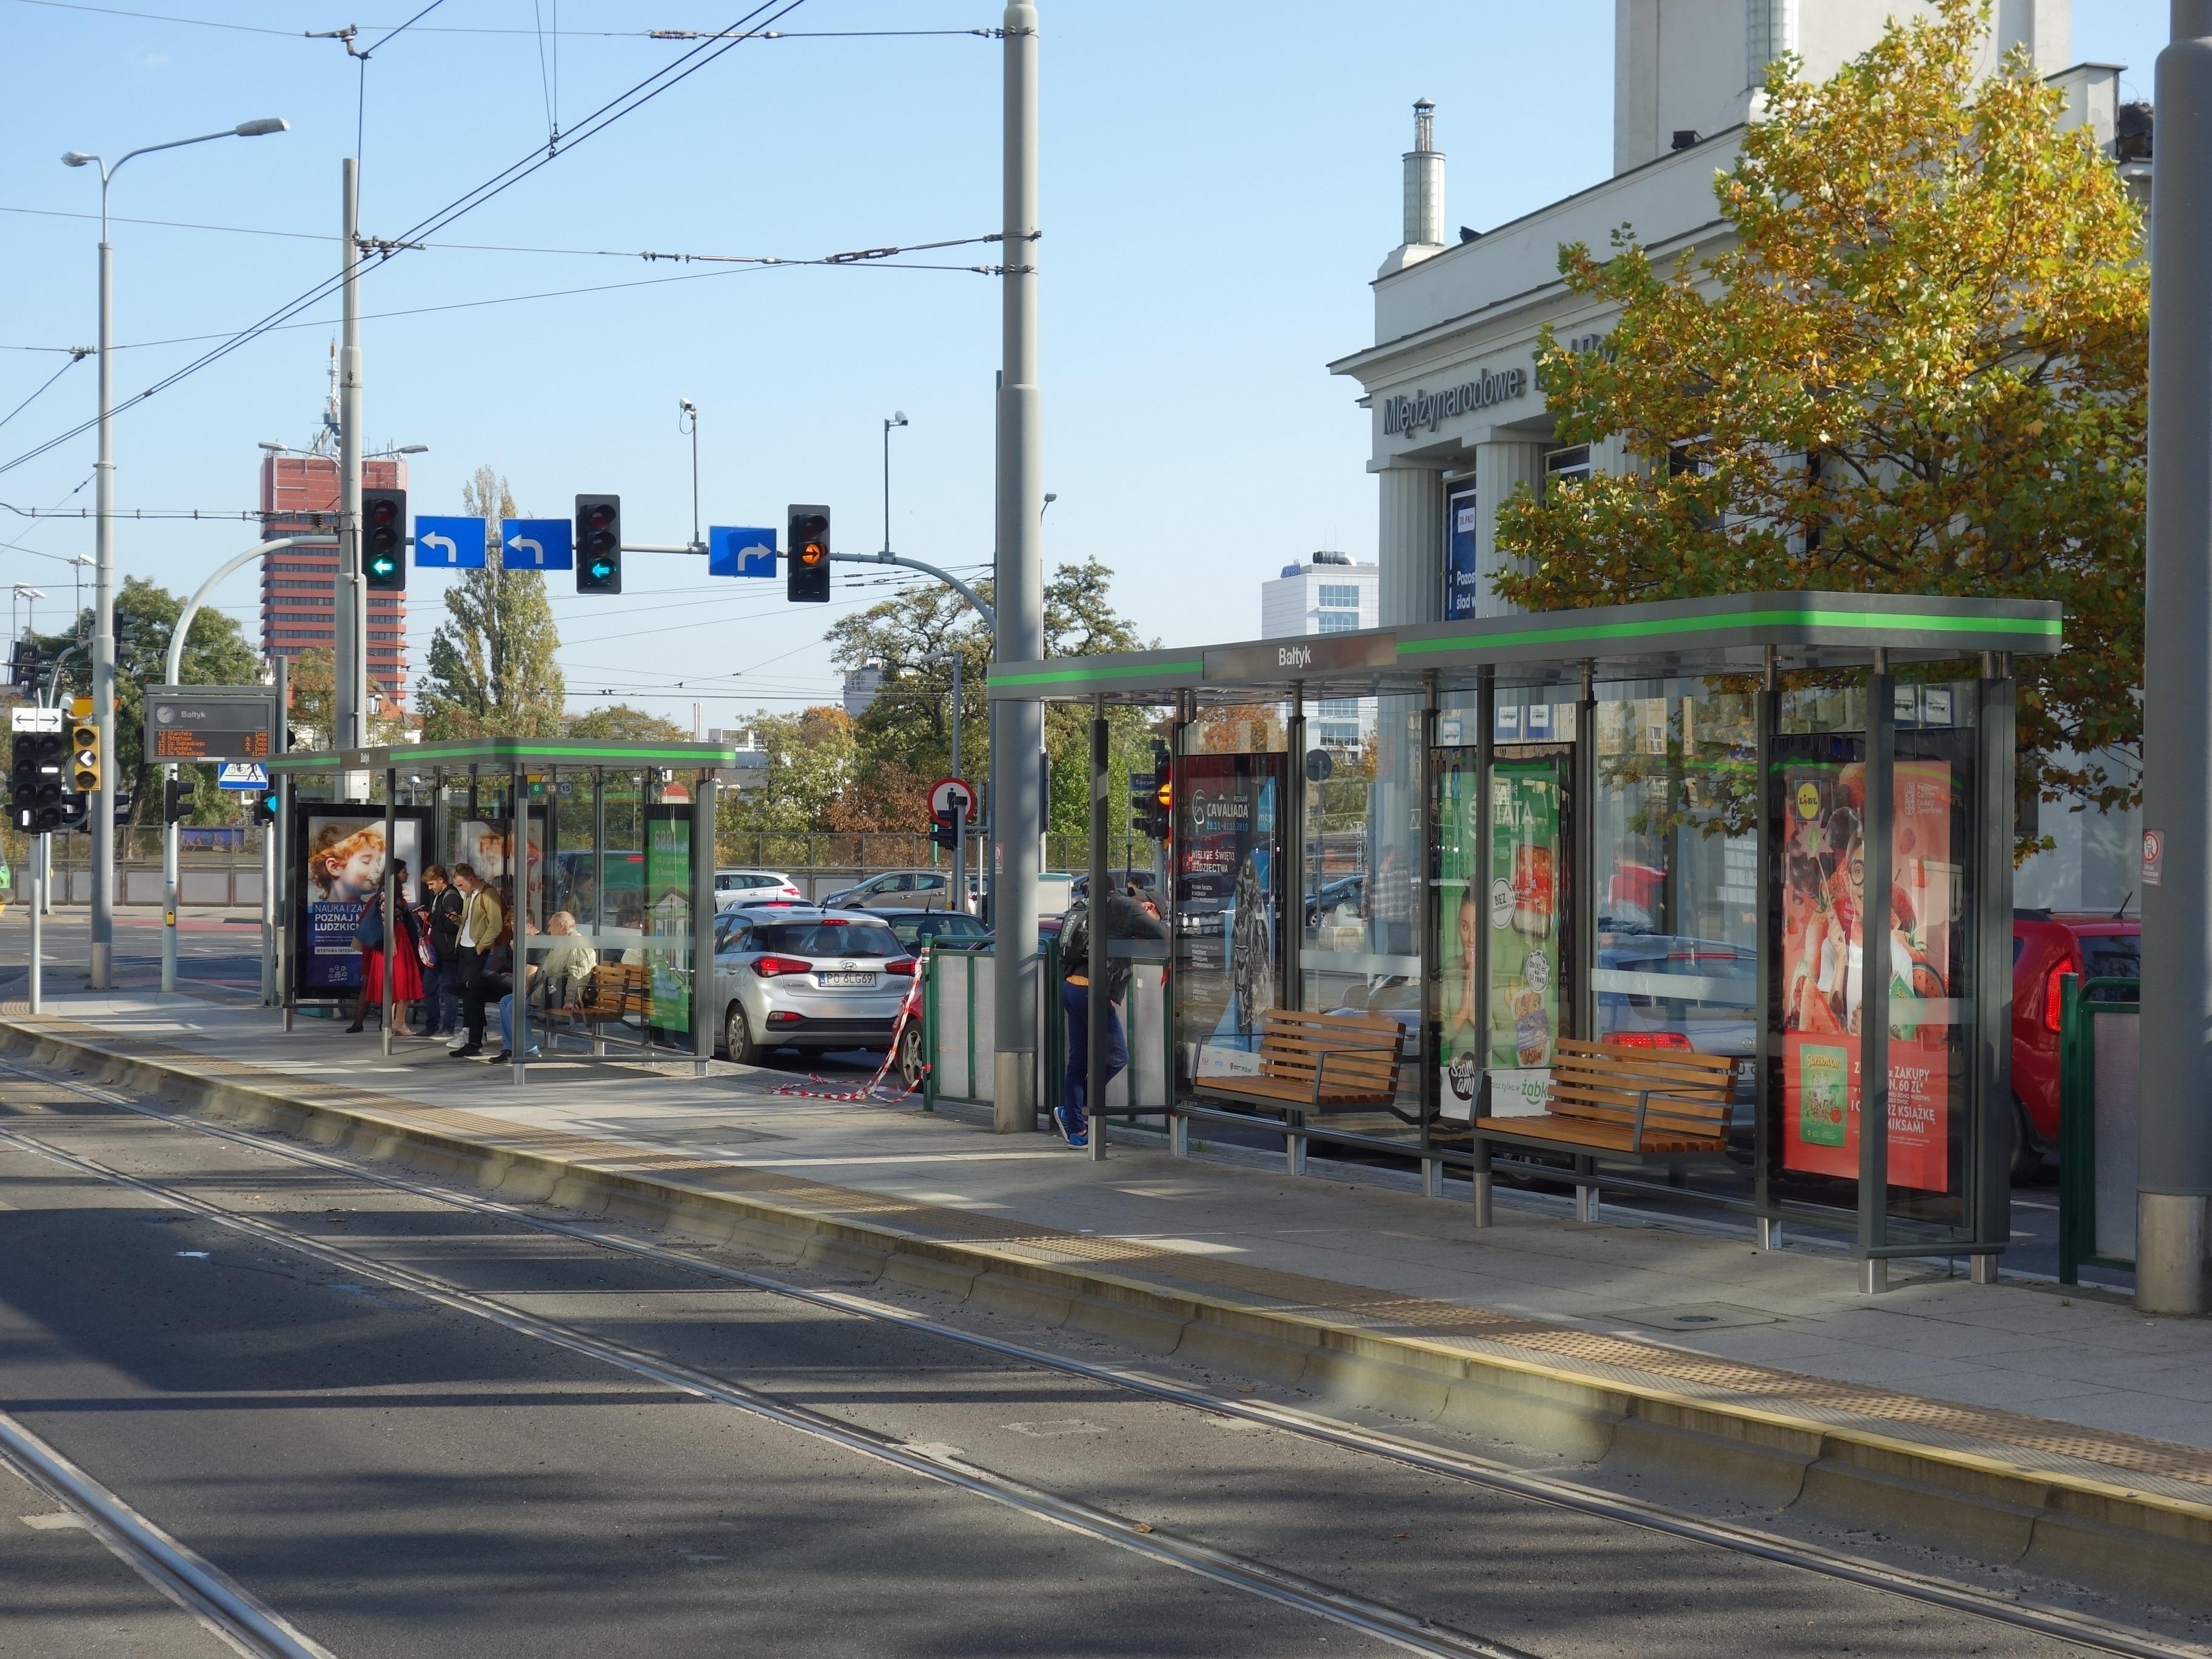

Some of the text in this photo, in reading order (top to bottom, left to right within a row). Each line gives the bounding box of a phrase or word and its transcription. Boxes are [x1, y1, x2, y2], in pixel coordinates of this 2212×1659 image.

[1456, 593, 1470, 609] ślad
[1279, 645, 1311, 668] Bałtyk
[181, 711, 206, 719] Bałtyk
[1207, 803, 1248, 818] CAVALIADA
[1469, 791, 1535, 825] ŚIATA
[655, 830, 672, 851] 600
[1192, 850, 1213, 860] WIELKIE
[1494, 893, 1507, 906] BEZ
[315, 904, 346, 913] NAUKA
[827, 973, 873, 984] PO 6LG69
[1806, 1053, 1841, 1069] SUPERMOCNI
[1894, 1066, 1930, 1082] ZAKUPY
[1502, 1081, 1515, 1093] tylko
[1899, 1080, 1909, 1092] 60
[1898, 1104, 1936, 1125] KSIĄŻKĘ
